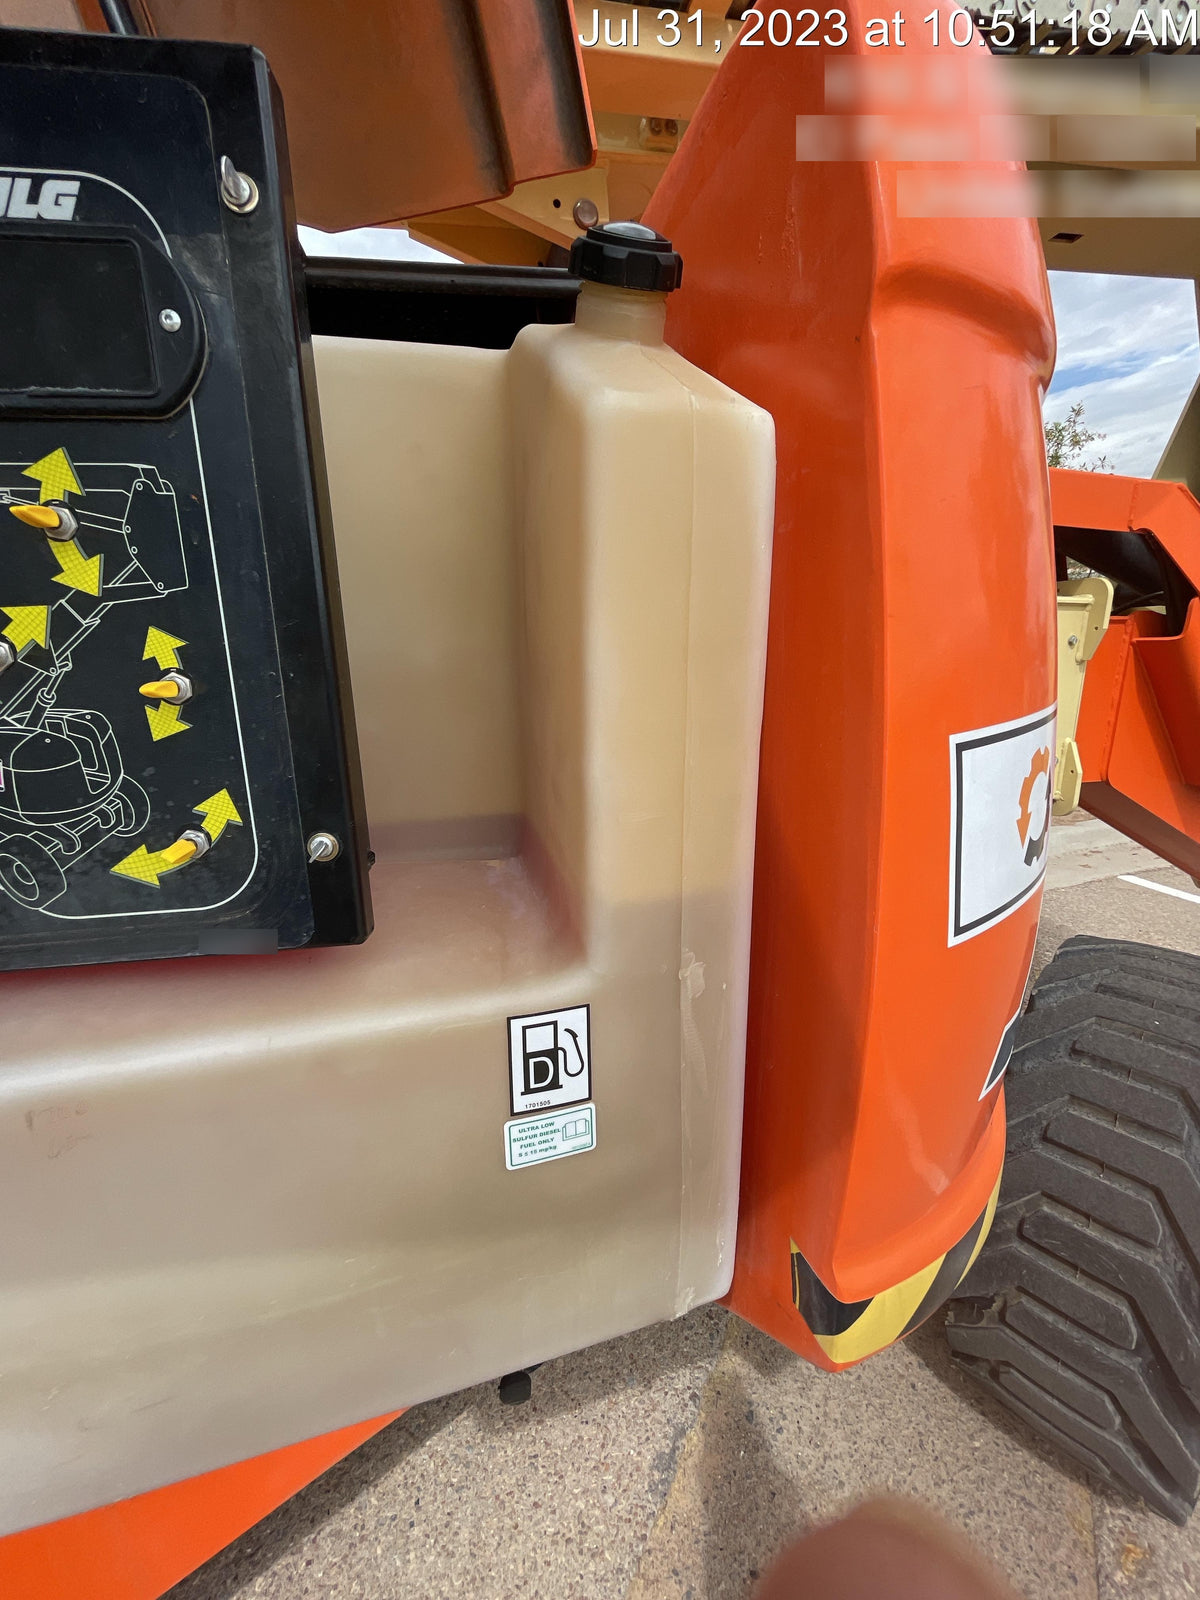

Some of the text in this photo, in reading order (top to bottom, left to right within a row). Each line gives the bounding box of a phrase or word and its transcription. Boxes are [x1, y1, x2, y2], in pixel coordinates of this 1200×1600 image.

[529, 1056, 554, 1089] D
[525, 1100, 551, 1109] 1701505
[518, 1125, 539, 1133] ULTRA
[512, 1128, 561, 1142] SULFUR DIESEL
